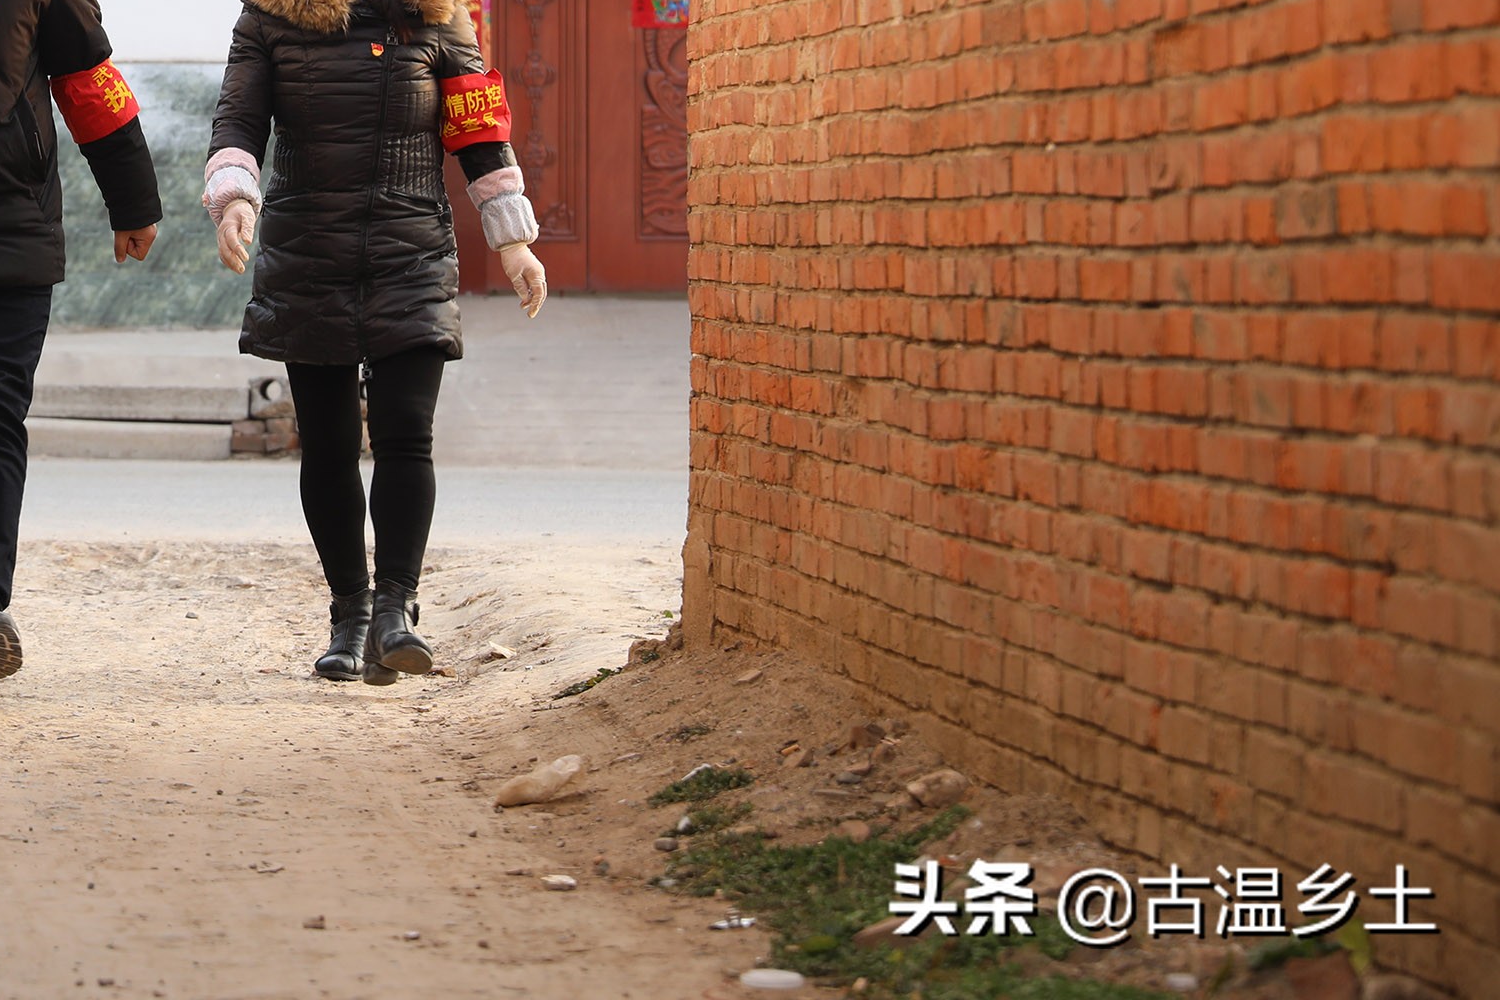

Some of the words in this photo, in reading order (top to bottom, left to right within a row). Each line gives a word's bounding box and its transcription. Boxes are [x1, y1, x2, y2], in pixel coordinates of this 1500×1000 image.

[92, 66, 113, 87] 武
[104, 79, 132, 114] 执
[444, 83, 503, 118] 情防控
